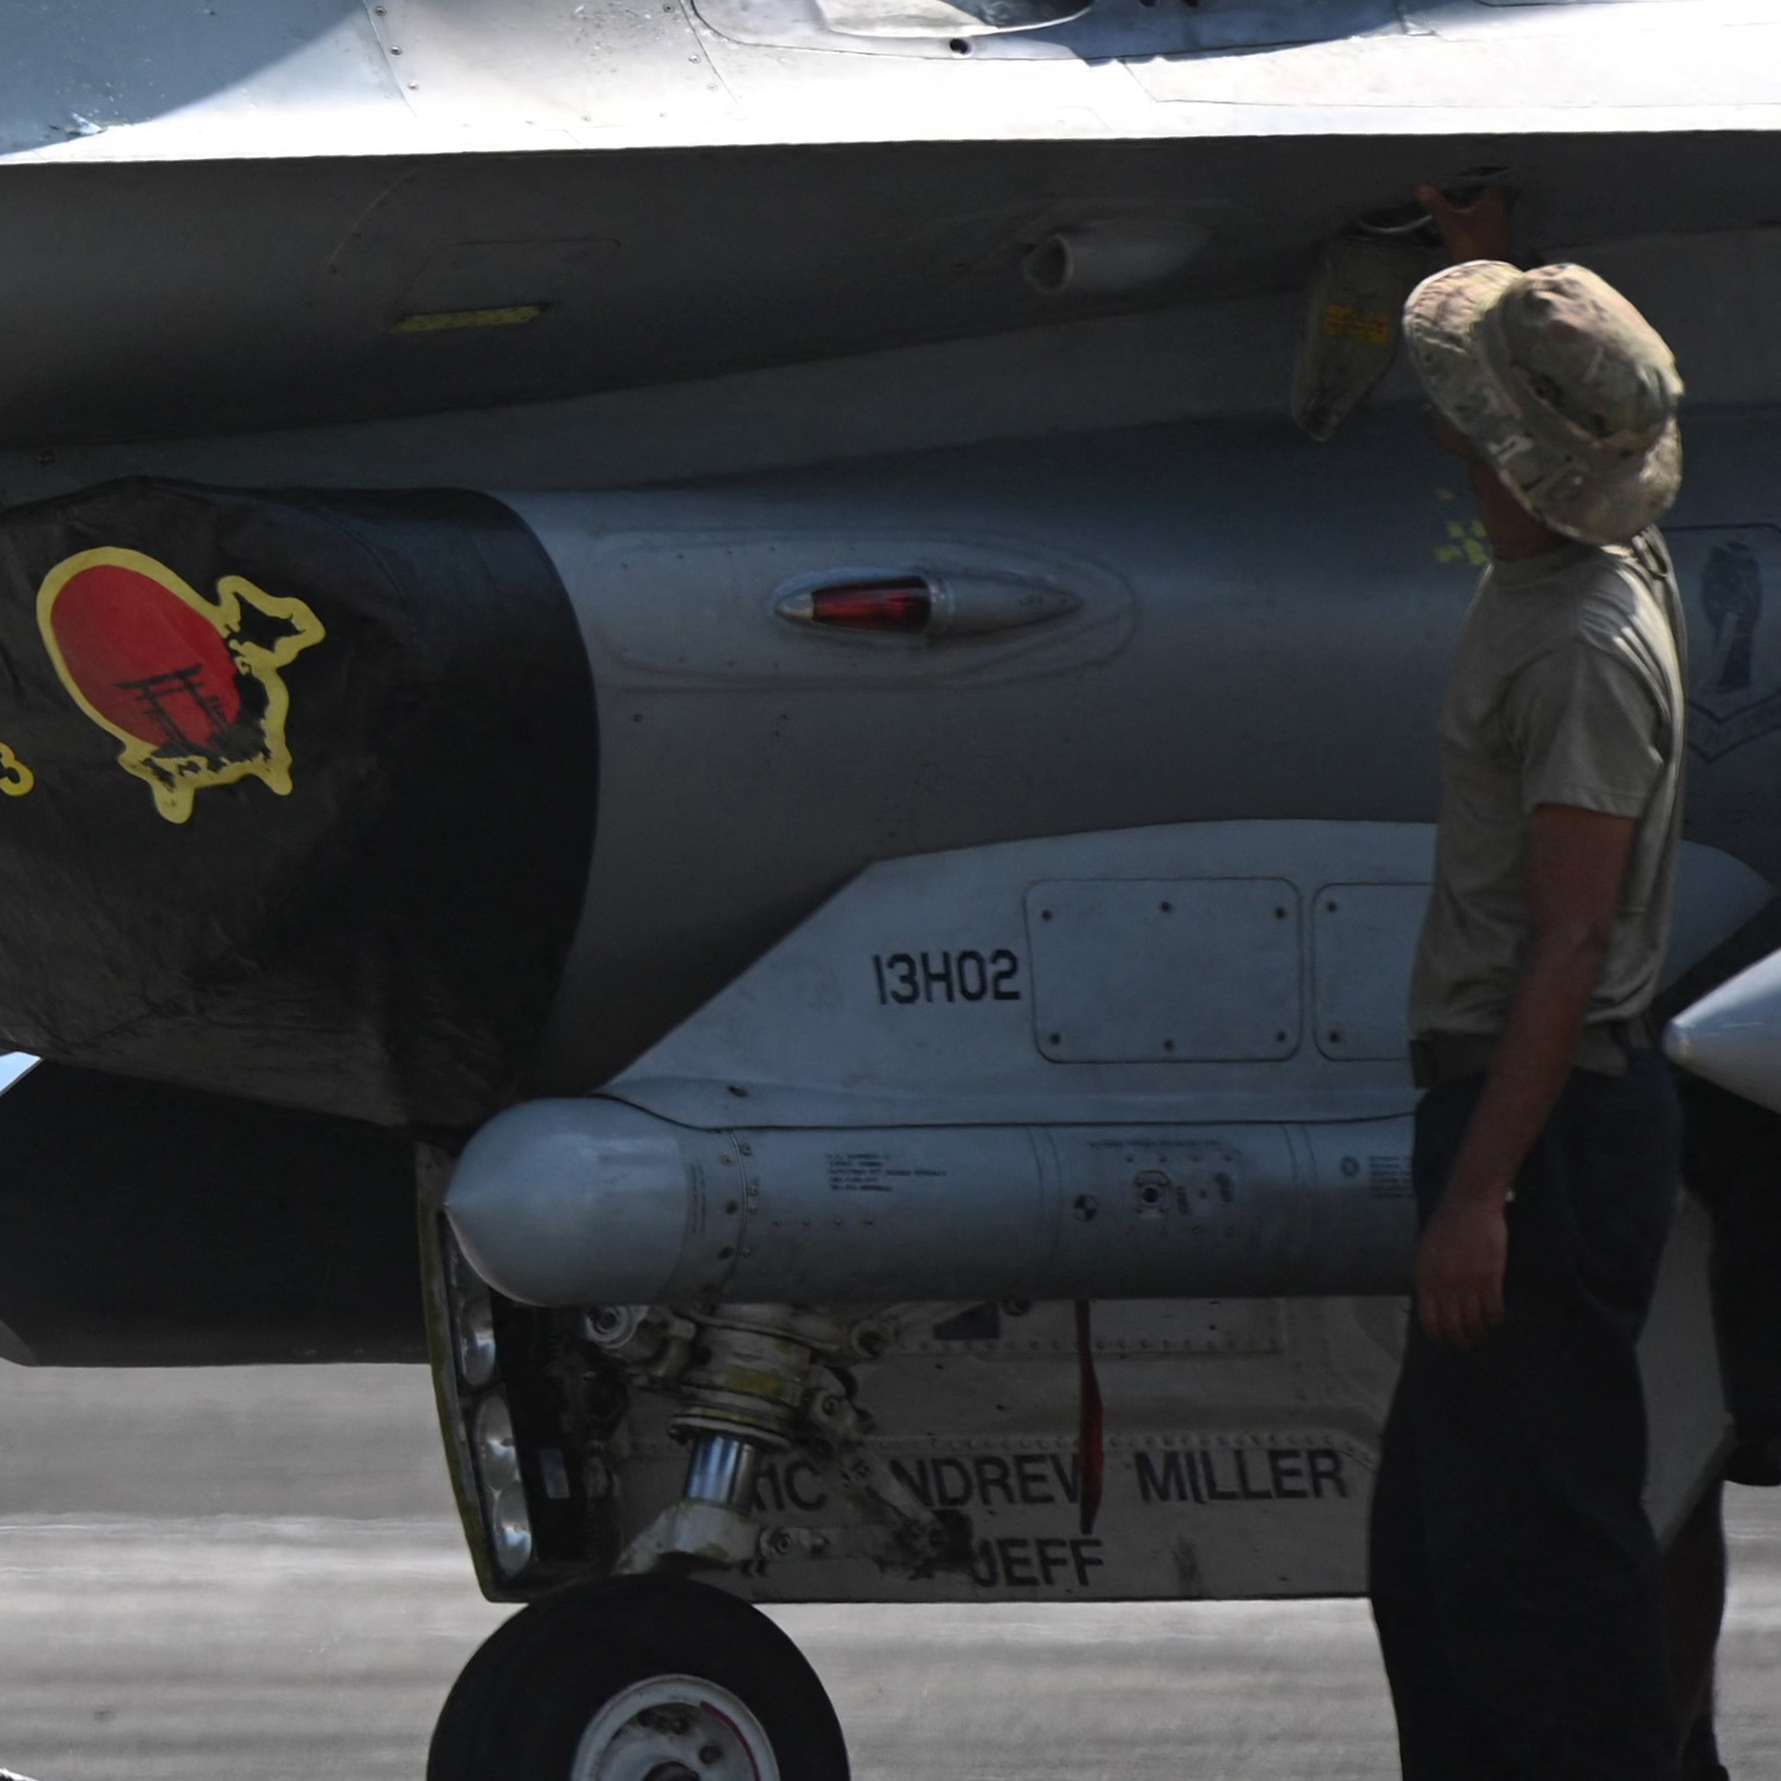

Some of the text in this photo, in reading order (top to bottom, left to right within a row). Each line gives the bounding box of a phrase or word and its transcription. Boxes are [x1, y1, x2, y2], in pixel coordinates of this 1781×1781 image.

[872, 949, 1020, 1006] 13H02
[1137, 1448, 1350, 1505] MILLER
[973, 1538, 1104, 1588] JEFF
